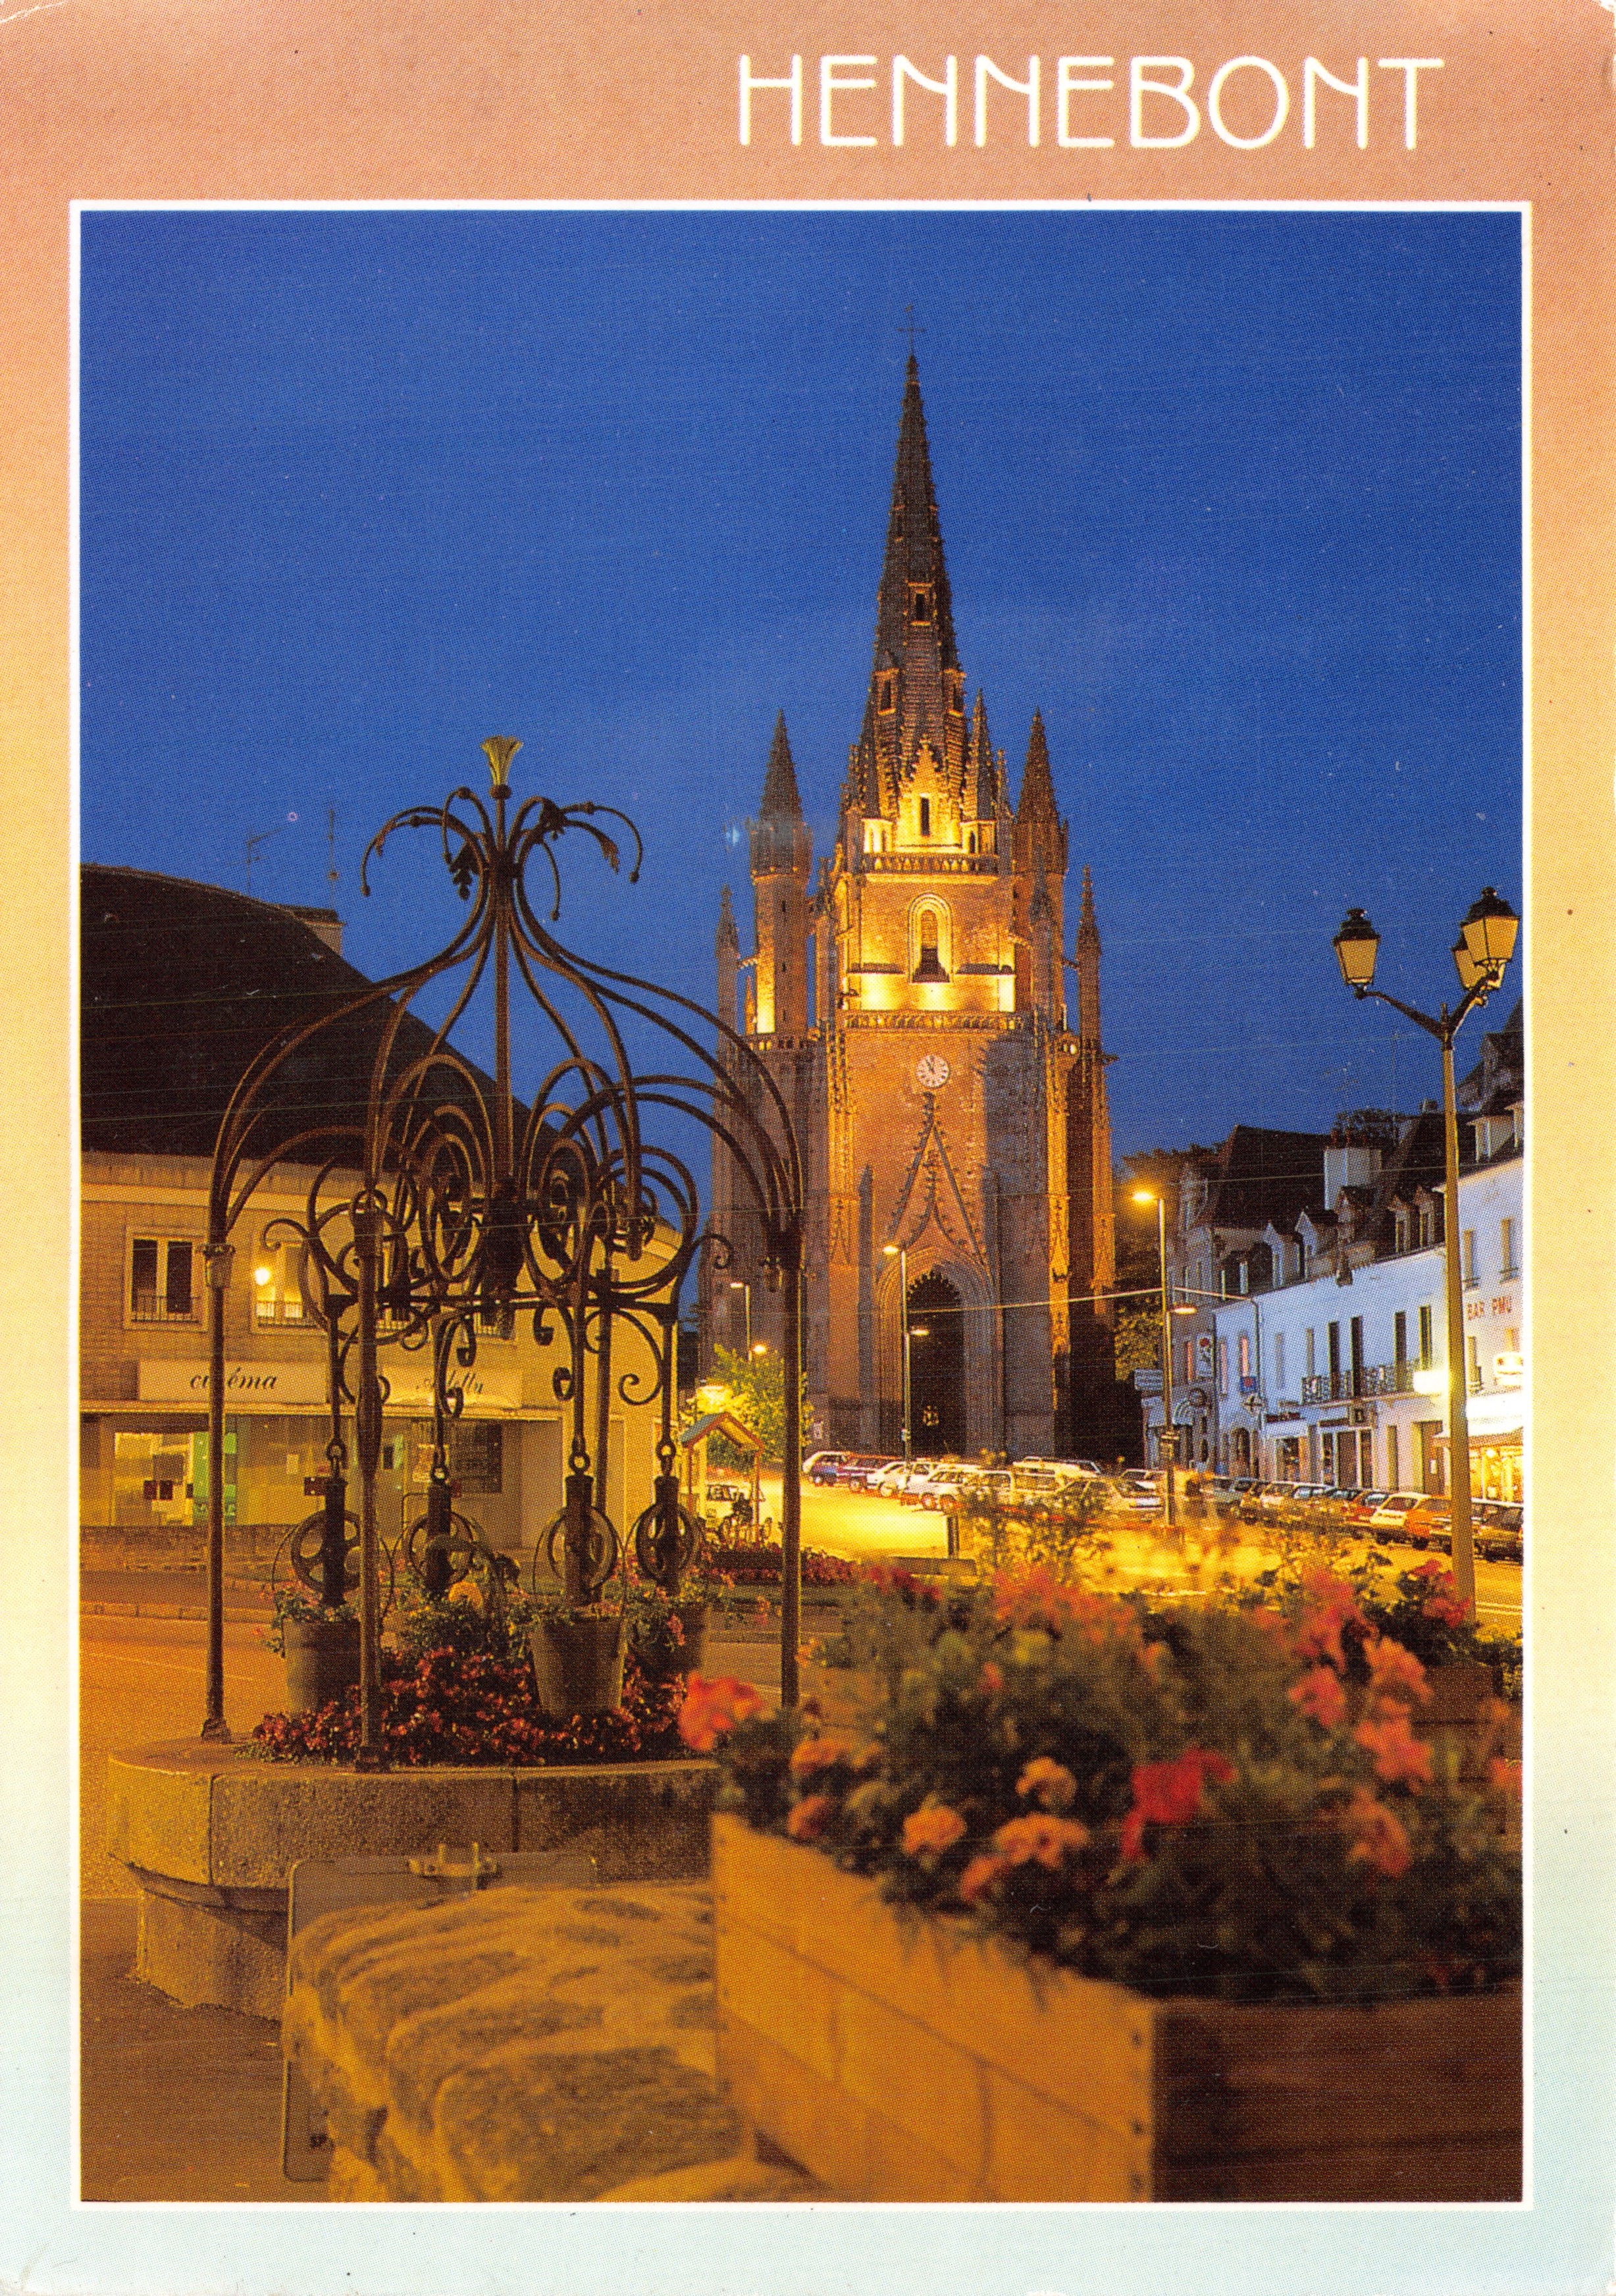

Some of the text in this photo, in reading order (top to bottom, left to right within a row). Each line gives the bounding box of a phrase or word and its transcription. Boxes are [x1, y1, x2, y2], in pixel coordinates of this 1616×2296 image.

[1467, 1295, 1513, 1321] BAR PMU
[190, 1367, 278, 1390] ciéma
